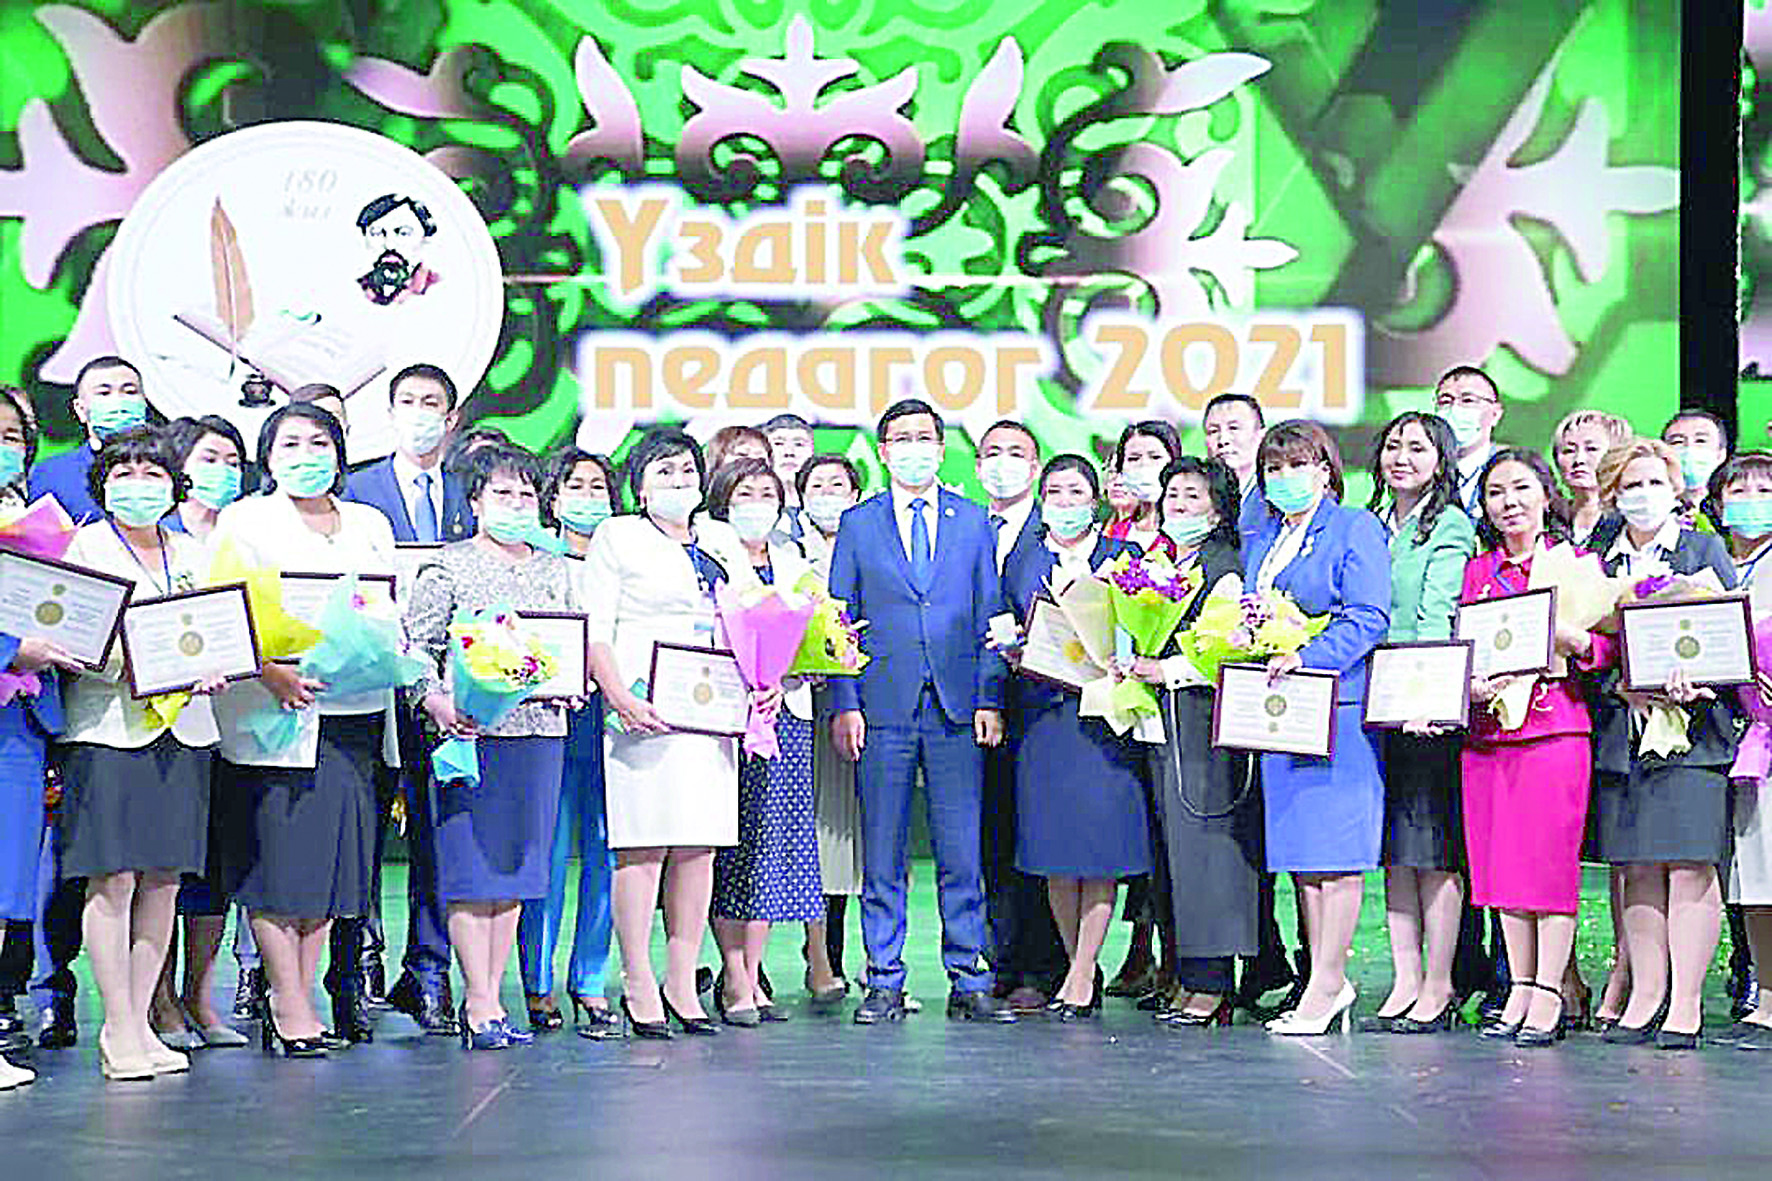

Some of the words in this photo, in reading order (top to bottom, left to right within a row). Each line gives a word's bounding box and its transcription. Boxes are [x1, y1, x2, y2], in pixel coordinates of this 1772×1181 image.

[283, 169, 338, 193] 180
[595, 345, 1042, 415] педагог
[1091, 323, 1347, 409] 2021
